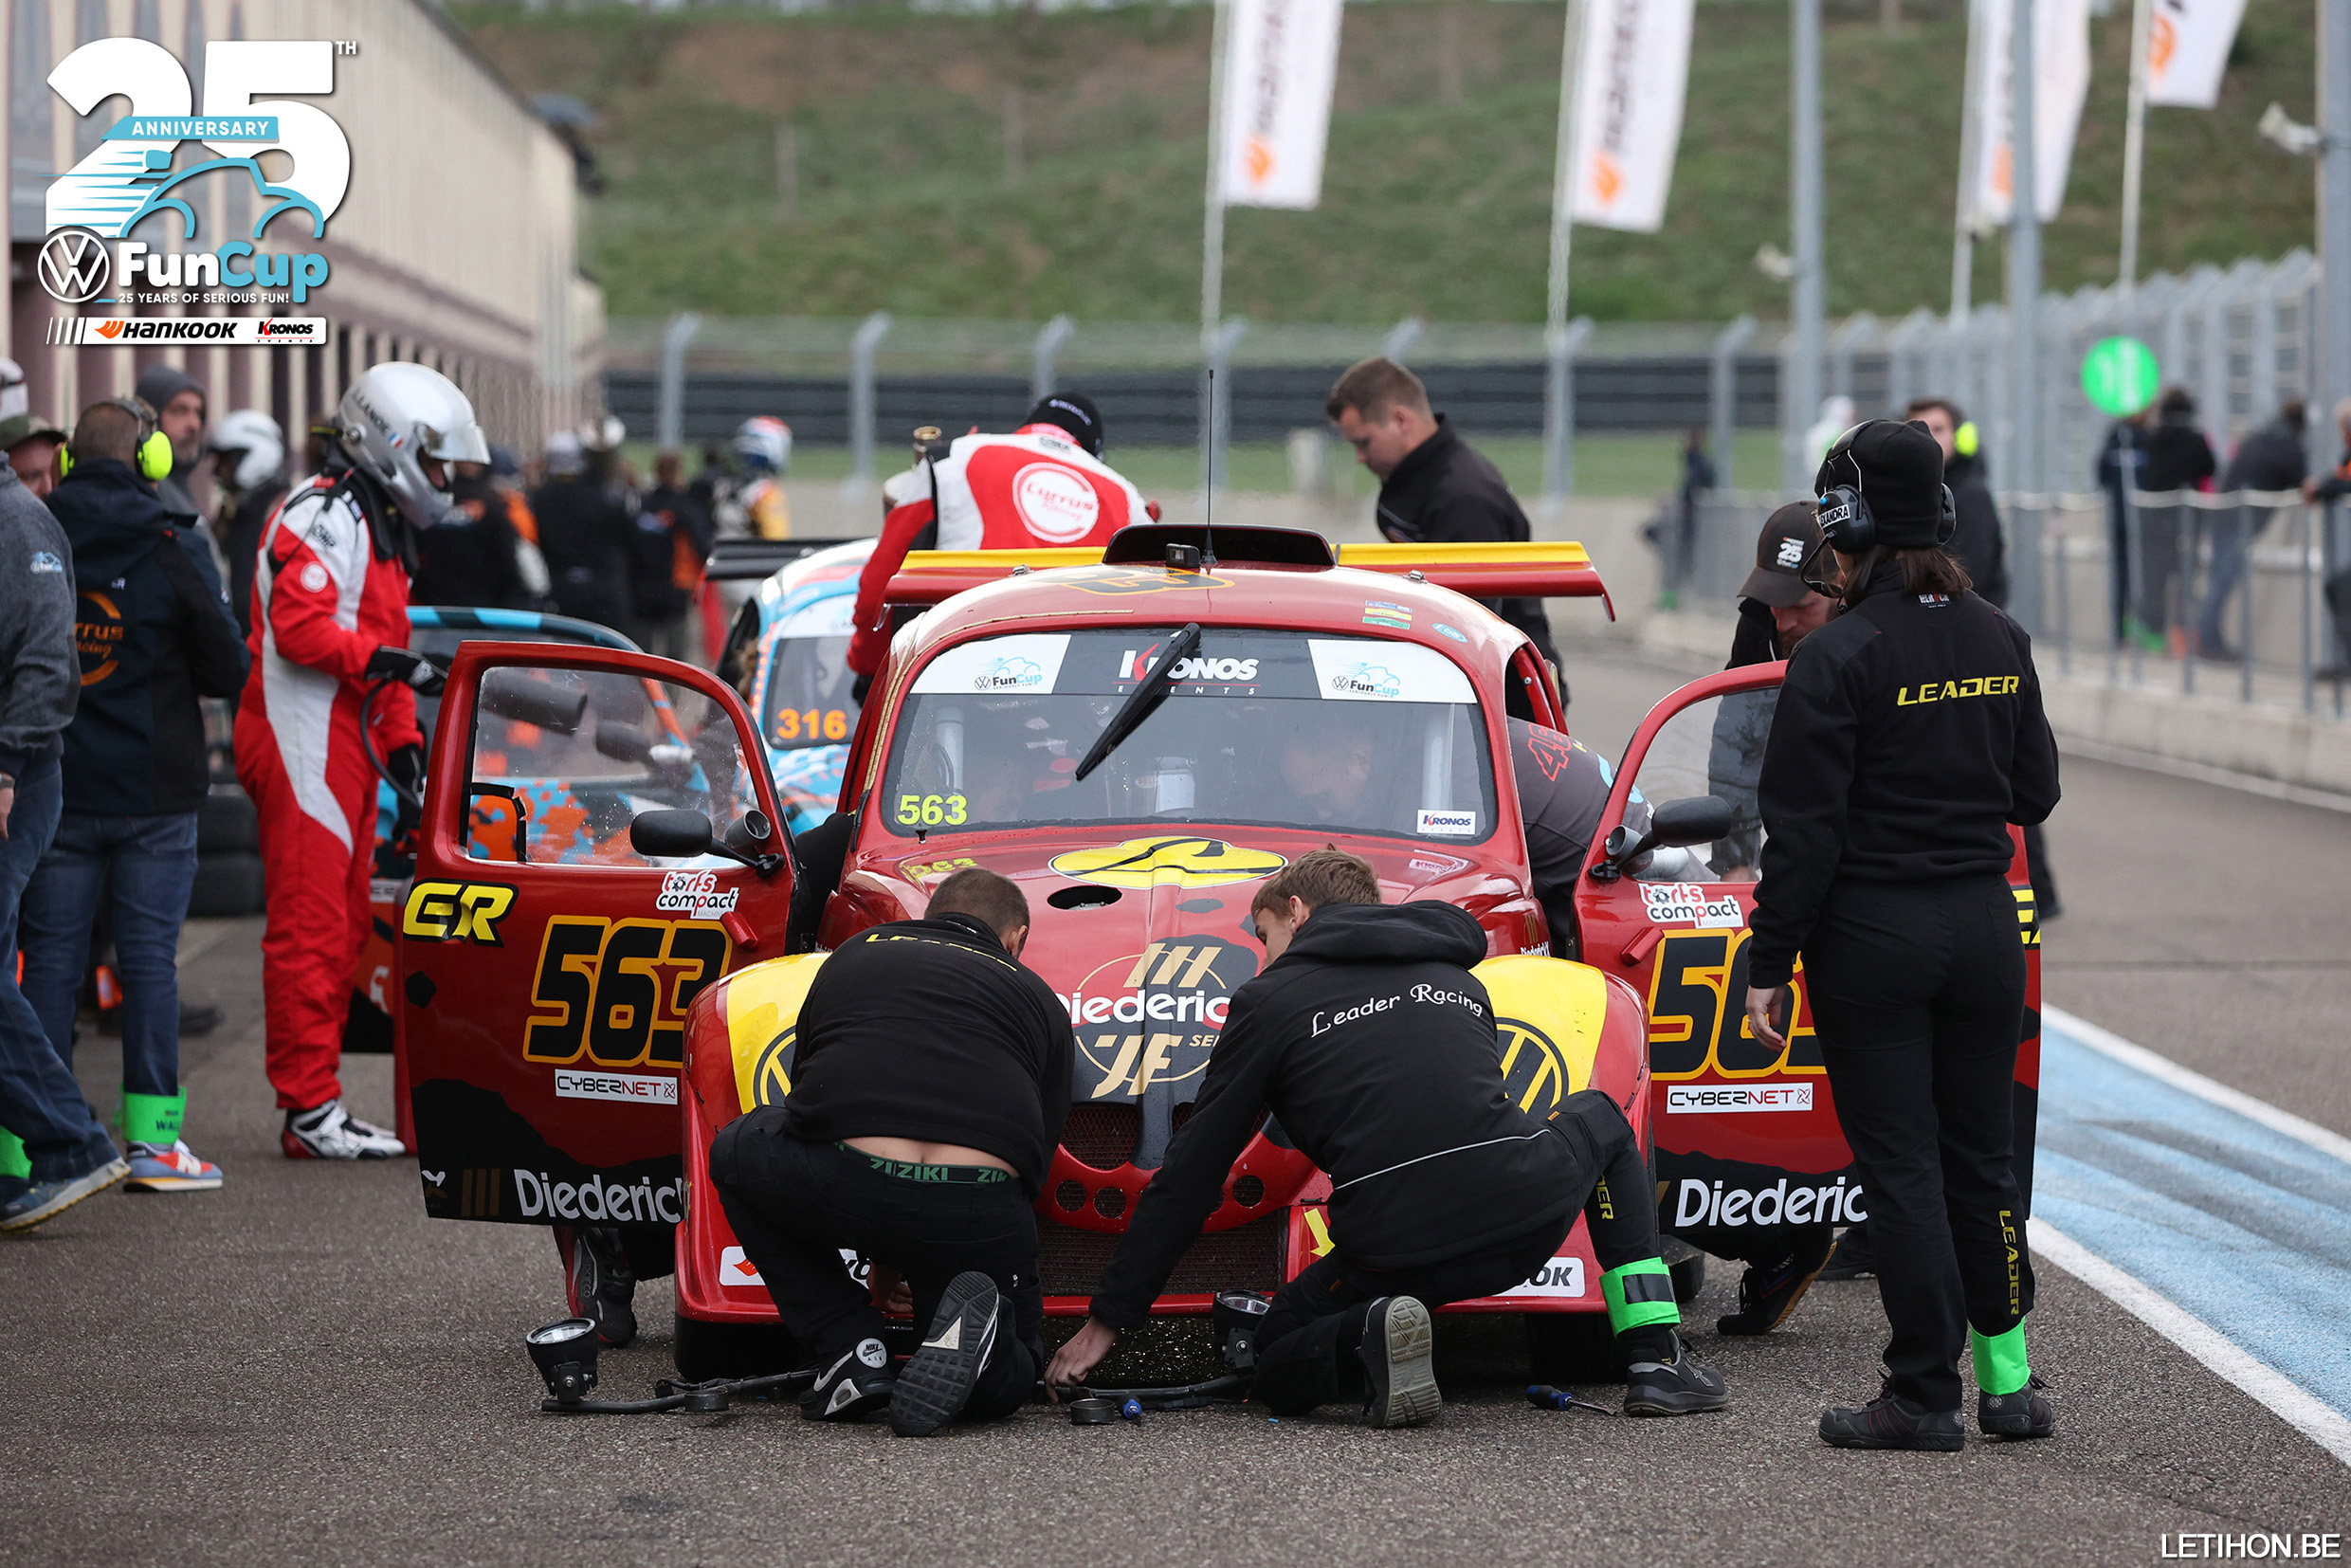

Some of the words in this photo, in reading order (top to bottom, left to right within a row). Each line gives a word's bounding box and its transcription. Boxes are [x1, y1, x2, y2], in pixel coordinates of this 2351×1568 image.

[1778, 541, 1804, 563] 25
[993, 673, 1043, 685] FunCup
[1117, 684, 1255, 695] EENTS
[1350, 680, 1400, 698] FunCup
[1897, 675, 2019, 706] LEADER
[777, 708, 847, 739] 316
[897, 794, 968, 825] 563
[1423, 812, 1471, 826] KRONOS
[659, 891, 736, 917] compact
[1650, 899, 1739, 926] compact
[522, 915, 733, 1068] 563
[1055, 990, 1230, 1024] iederic
[1649, 928, 1827, 1081] 56
[1311, 995, 1400, 1038] Leader
[1410, 983, 1483, 1017] Racing
[514, 1169, 683, 1223] Diederic
[1675, 1176, 1868, 1228] Diederic
[1998, 1210, 2019, 1315] LEADER
